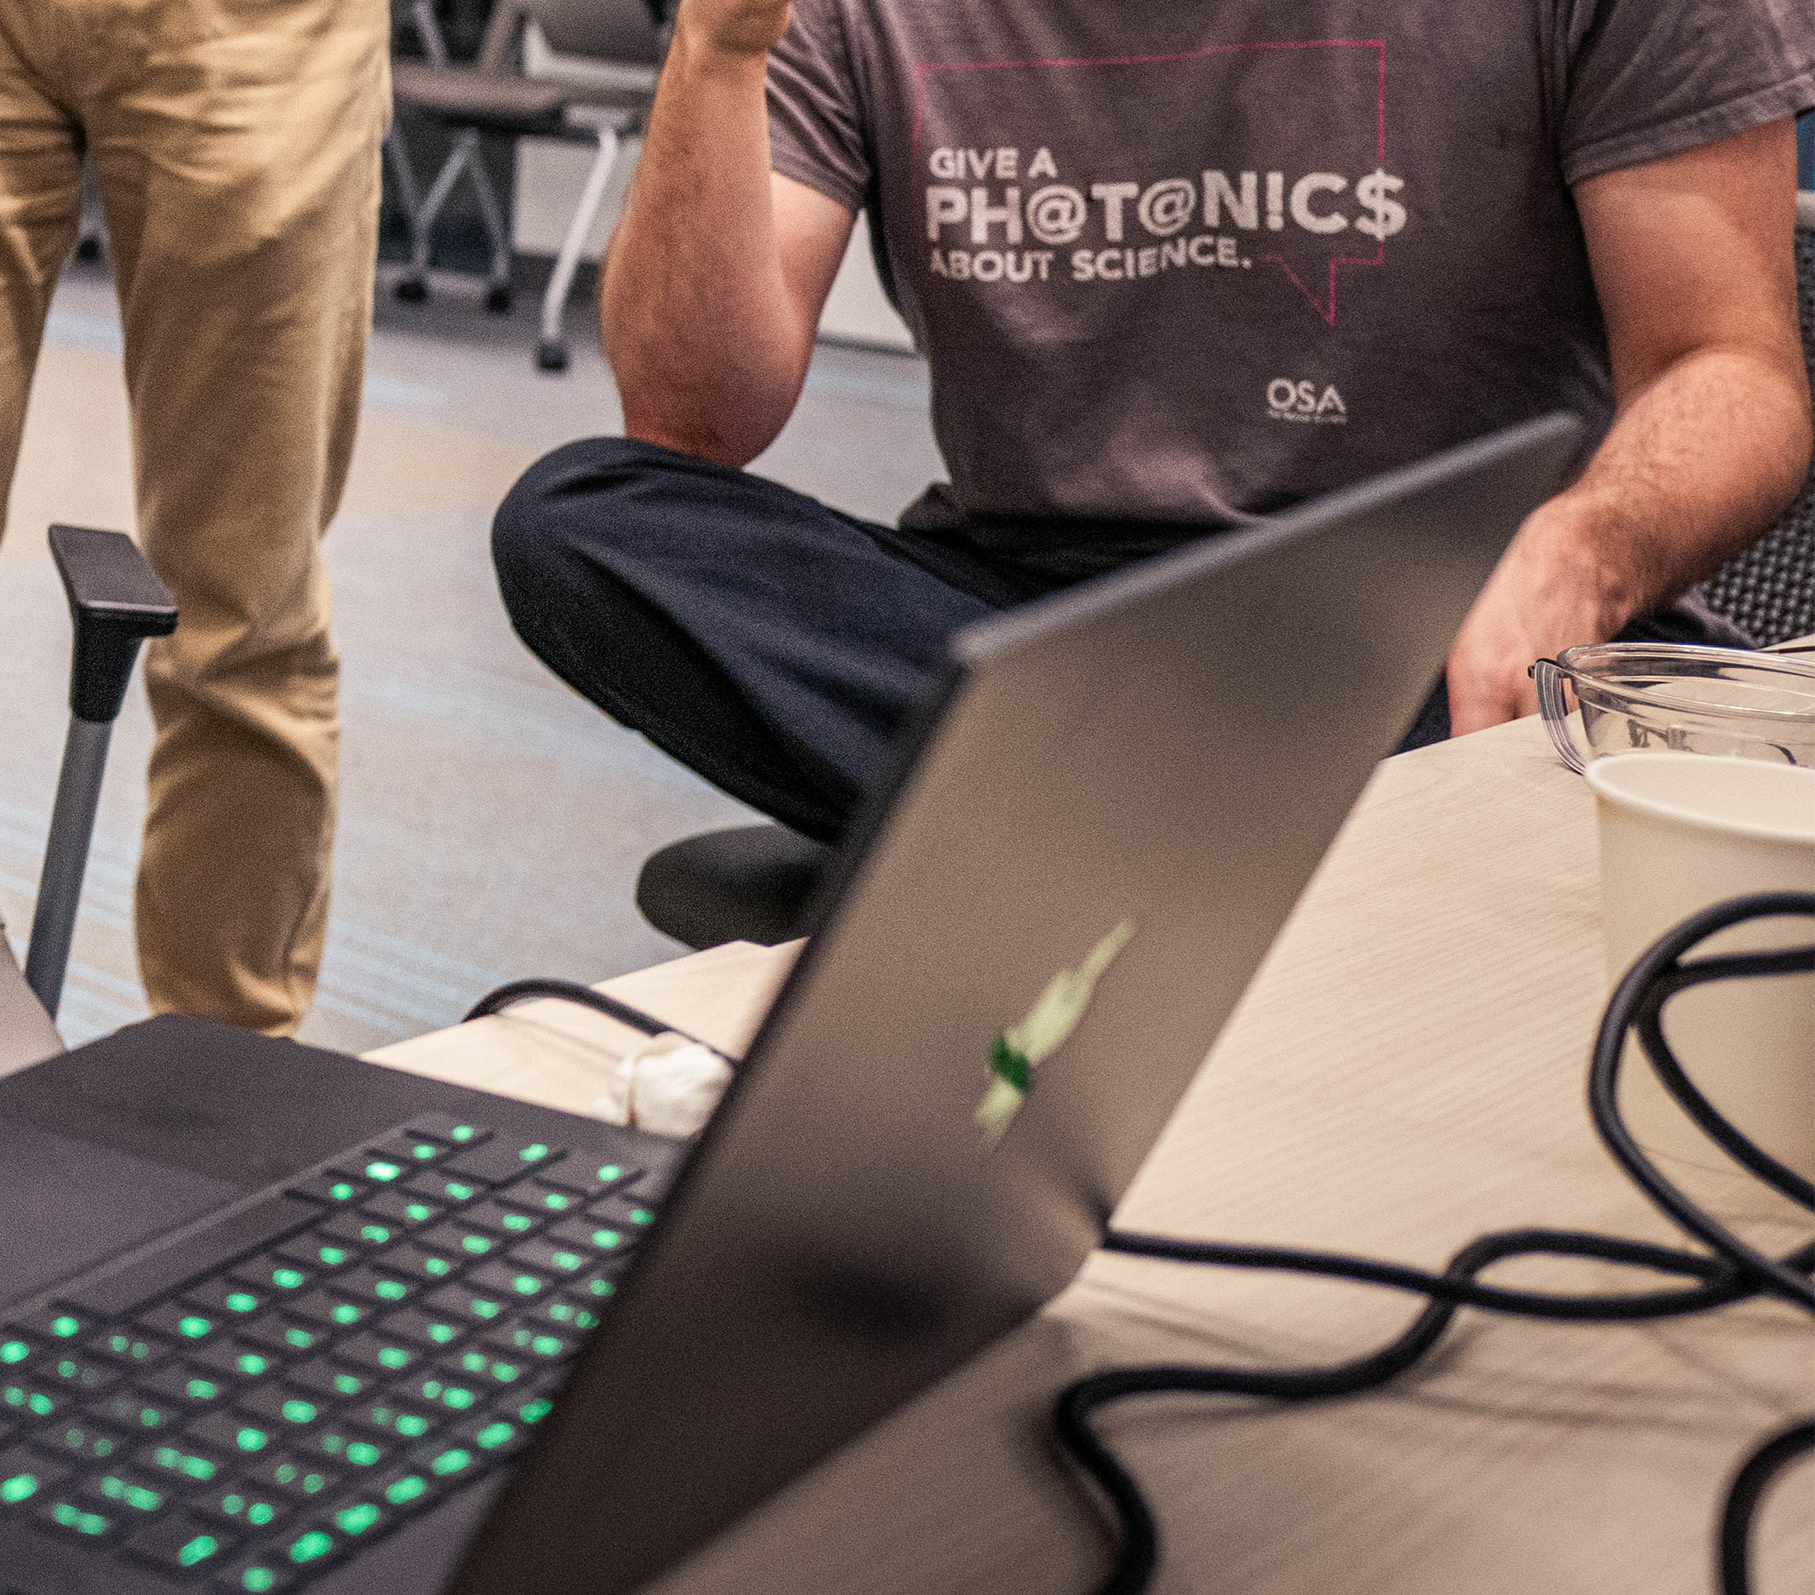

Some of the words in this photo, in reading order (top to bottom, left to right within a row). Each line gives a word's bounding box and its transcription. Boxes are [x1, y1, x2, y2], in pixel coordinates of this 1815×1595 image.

[928, 147, 1020, 180] GIVE
[1028, 146, 1058, 179] A
[930, 250, 1055, 283] ABOUT
[1071, 235, 1253, 282] SCIENCE.
[1266, 377, 1347, 414] OSA
